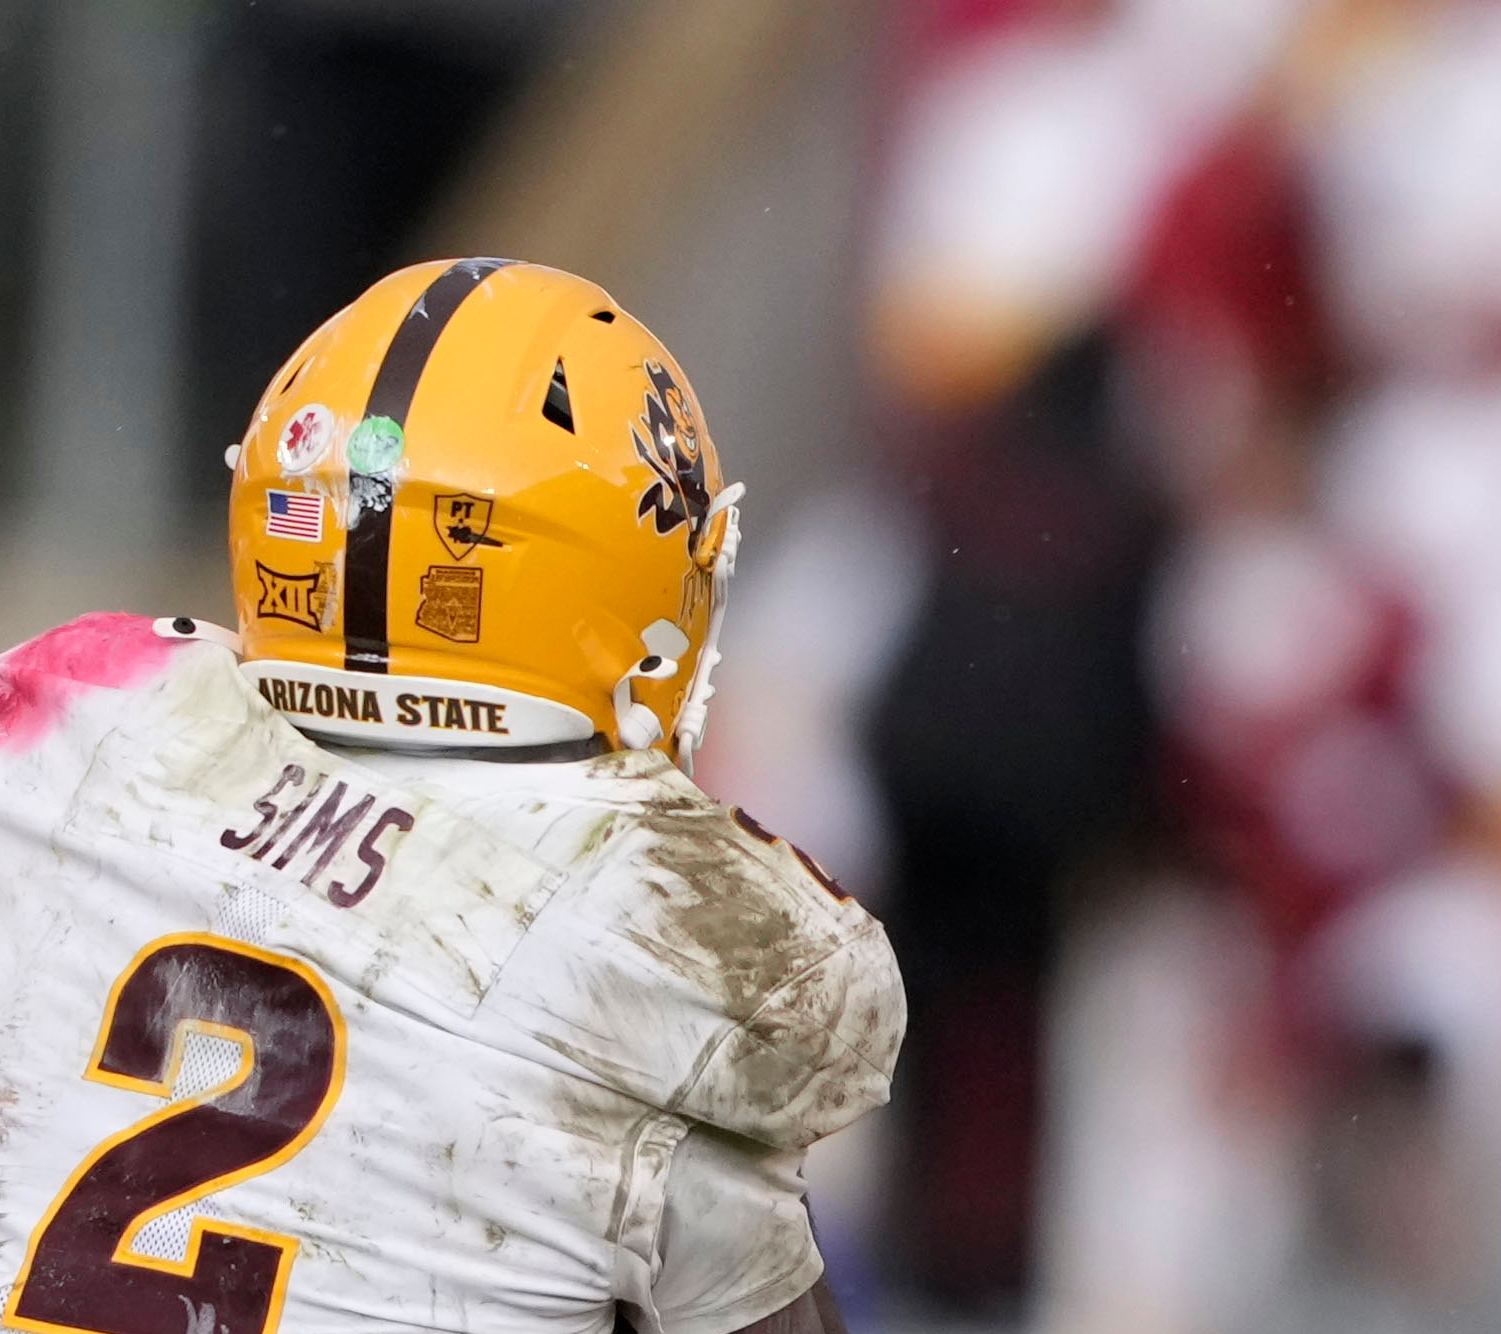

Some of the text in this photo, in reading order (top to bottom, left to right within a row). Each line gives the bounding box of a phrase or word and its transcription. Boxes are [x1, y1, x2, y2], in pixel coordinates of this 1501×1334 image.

[451, 501, 475, 519] PT
[258, 677, 510, 735] ARIZONA STATE
[220, 763, 415, 909] SIMS
